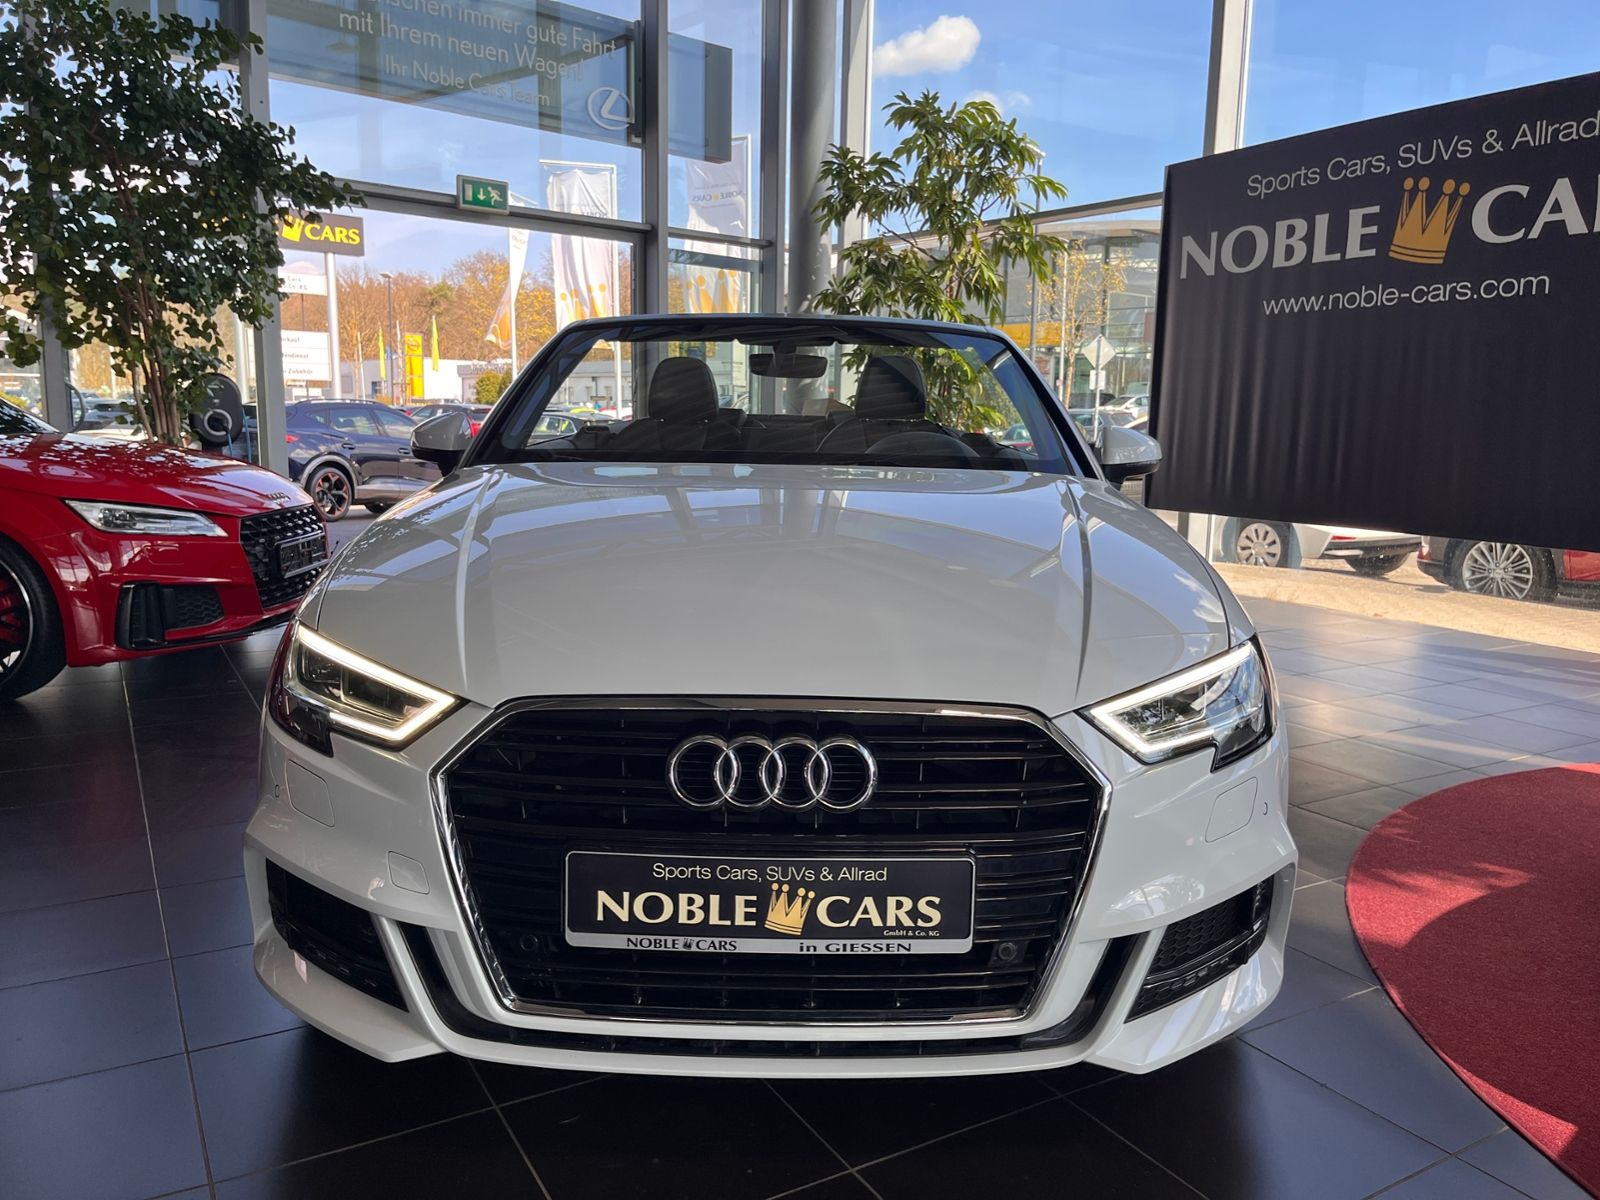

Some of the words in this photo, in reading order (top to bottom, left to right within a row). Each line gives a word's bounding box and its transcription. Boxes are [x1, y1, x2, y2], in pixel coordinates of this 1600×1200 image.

[339, 11, 374, 35] mit
[380, 11, 442, 49] Ihrem
[447, 36, 510, 64] neuen
[458, 6, 521, 36] immer
[526, 24, 568, 48] gute
[572, 26, 618, 60] Fahrt
[384, 54, 407, 76] Ihr
[412, 59, 465, 89] Noble
[1247, 166, 1321, 200] Sports
[1326, 154, 1391, 181] Cars,
[1397, 135, 1473, 169] SUVs
[1481, 129, 1504, 154] &
[1511, 109, 1600, 150] Allrad
[304, 223, 361, 246] CARS
[1179, 205, 1381, 280] NOBLE
[1262, 275, 1550, 316] www.noble-cars.com
[652, 862, 712, 881] Sports
[716, 865, 762, 882] Cars,
[766, 866, 816, 882] SUVs
[819, 867, 834, 882] &
[837, 866, 888, 882] Allrad
[596, 890, 758, 926] NOBLE
[816, 895, 942, 928] CARS
[626, 937, 680, 950] NOBLE
[695, 940, 738, 951] CARS
[799, 942, 817, 952] in
[825, 942, 912, 953] GIESSEN
[883, 929, 907, 937] GmbH
